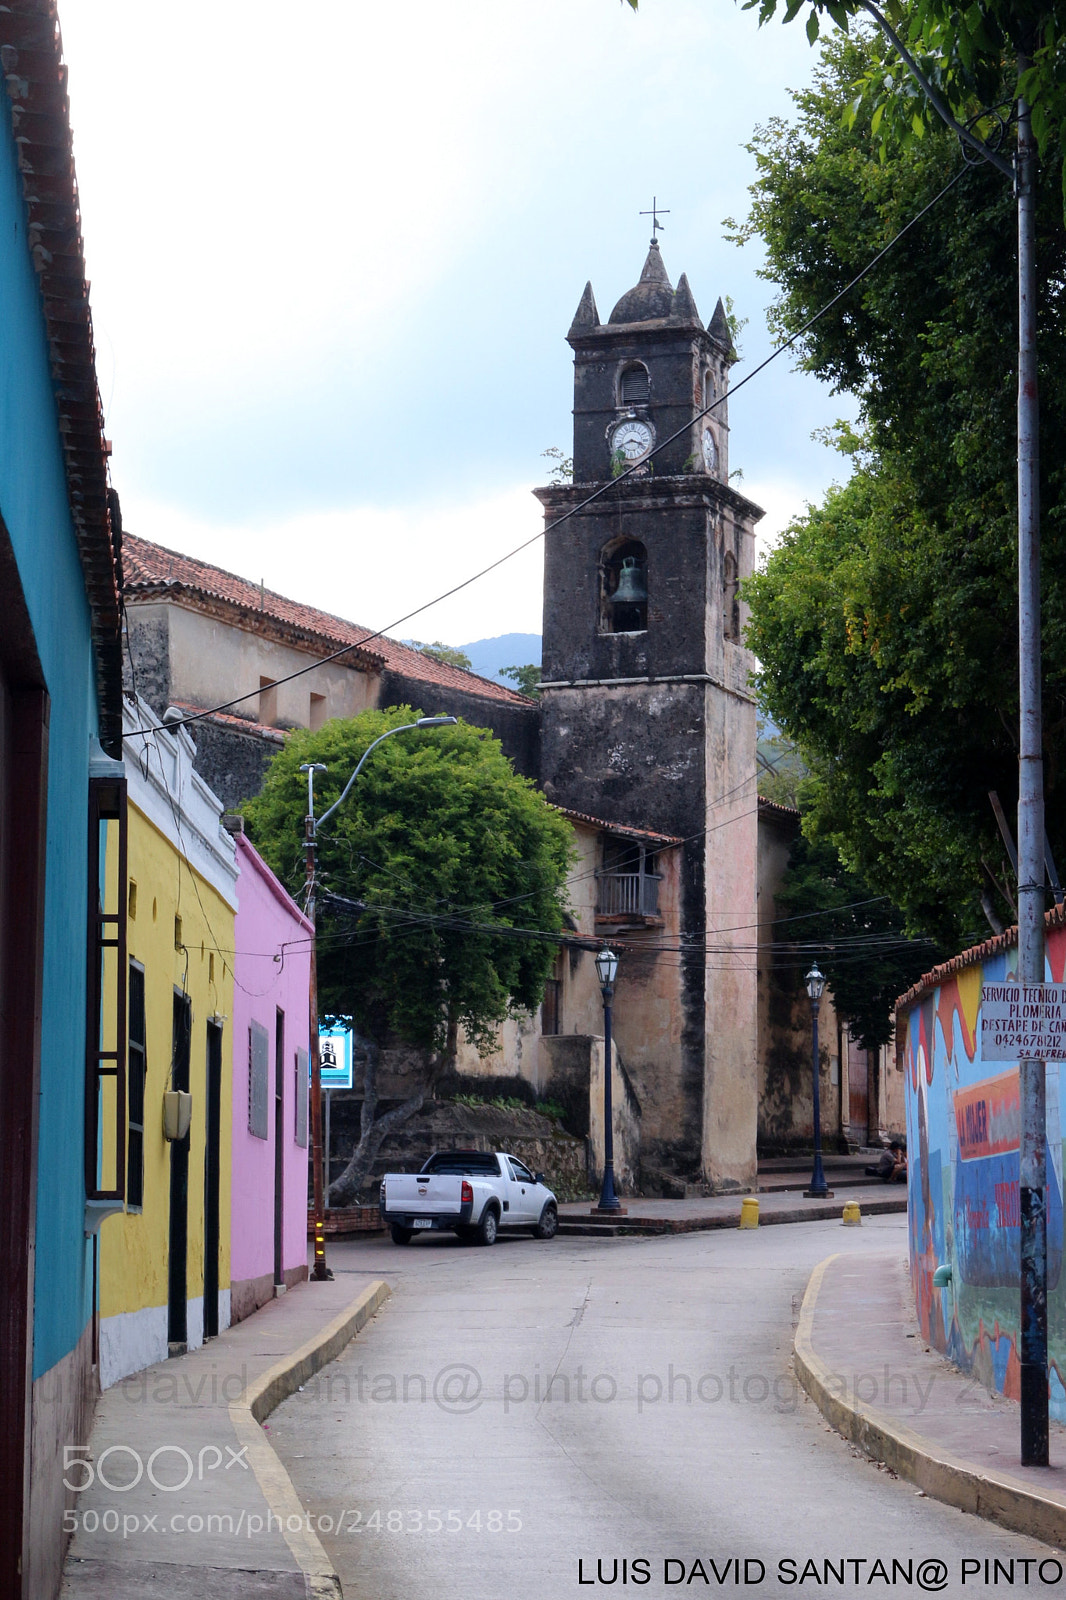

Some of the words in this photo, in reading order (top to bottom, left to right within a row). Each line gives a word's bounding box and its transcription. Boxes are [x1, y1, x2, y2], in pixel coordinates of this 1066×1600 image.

[981, 986, 1020, 1002] SERVICIO
[1022, 987, 1058, 1003] TECNICO
[1009, 1003, 1061, 1019] PLOMERIA
[981, 1018, 1028, 1032] DESTAPE
